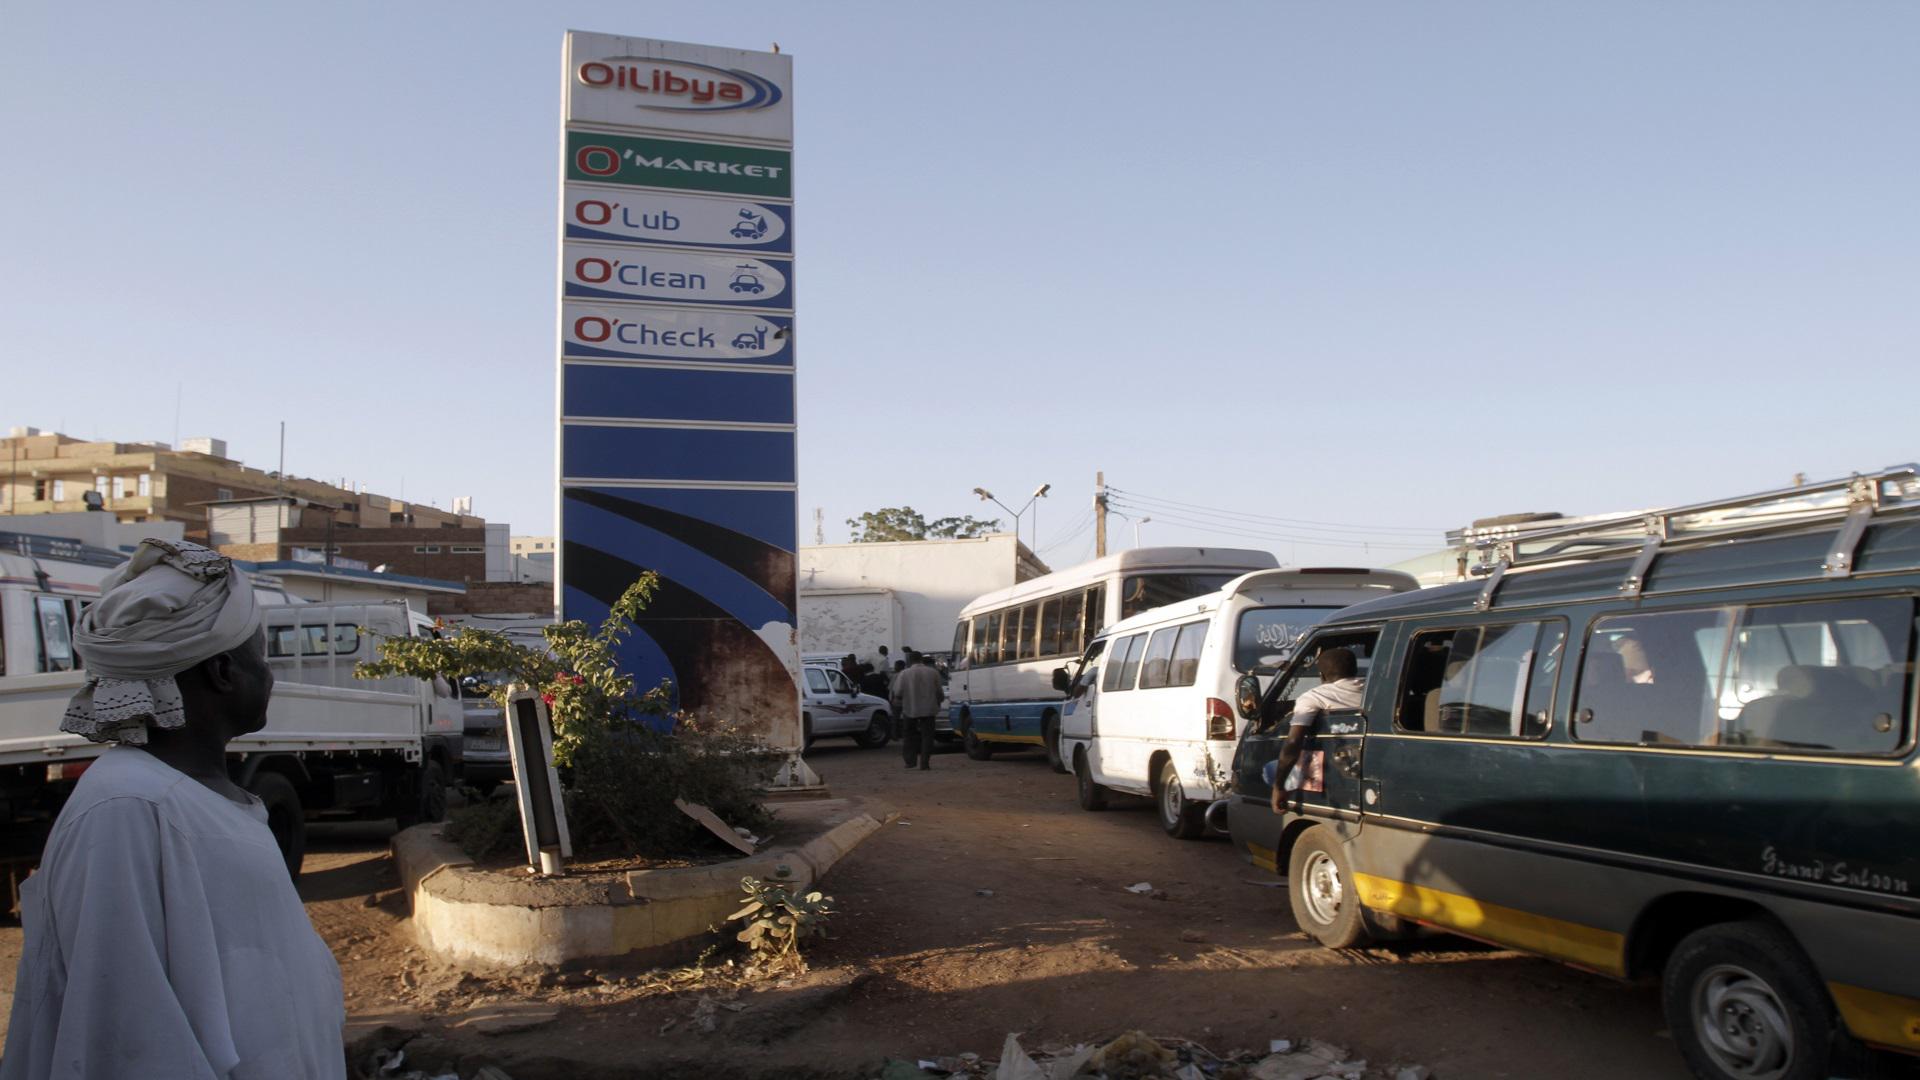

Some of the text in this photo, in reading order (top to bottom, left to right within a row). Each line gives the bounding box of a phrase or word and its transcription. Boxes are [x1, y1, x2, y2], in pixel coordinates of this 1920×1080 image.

[576, 145, 783, 178] O'MARKET
[575, 200, 681, 231] O'Lub
[575, 257, 706, 290] O'Clean
[574, 316, 715, 348] O'Check
[1830, 862, 1909, 893] Saloon
